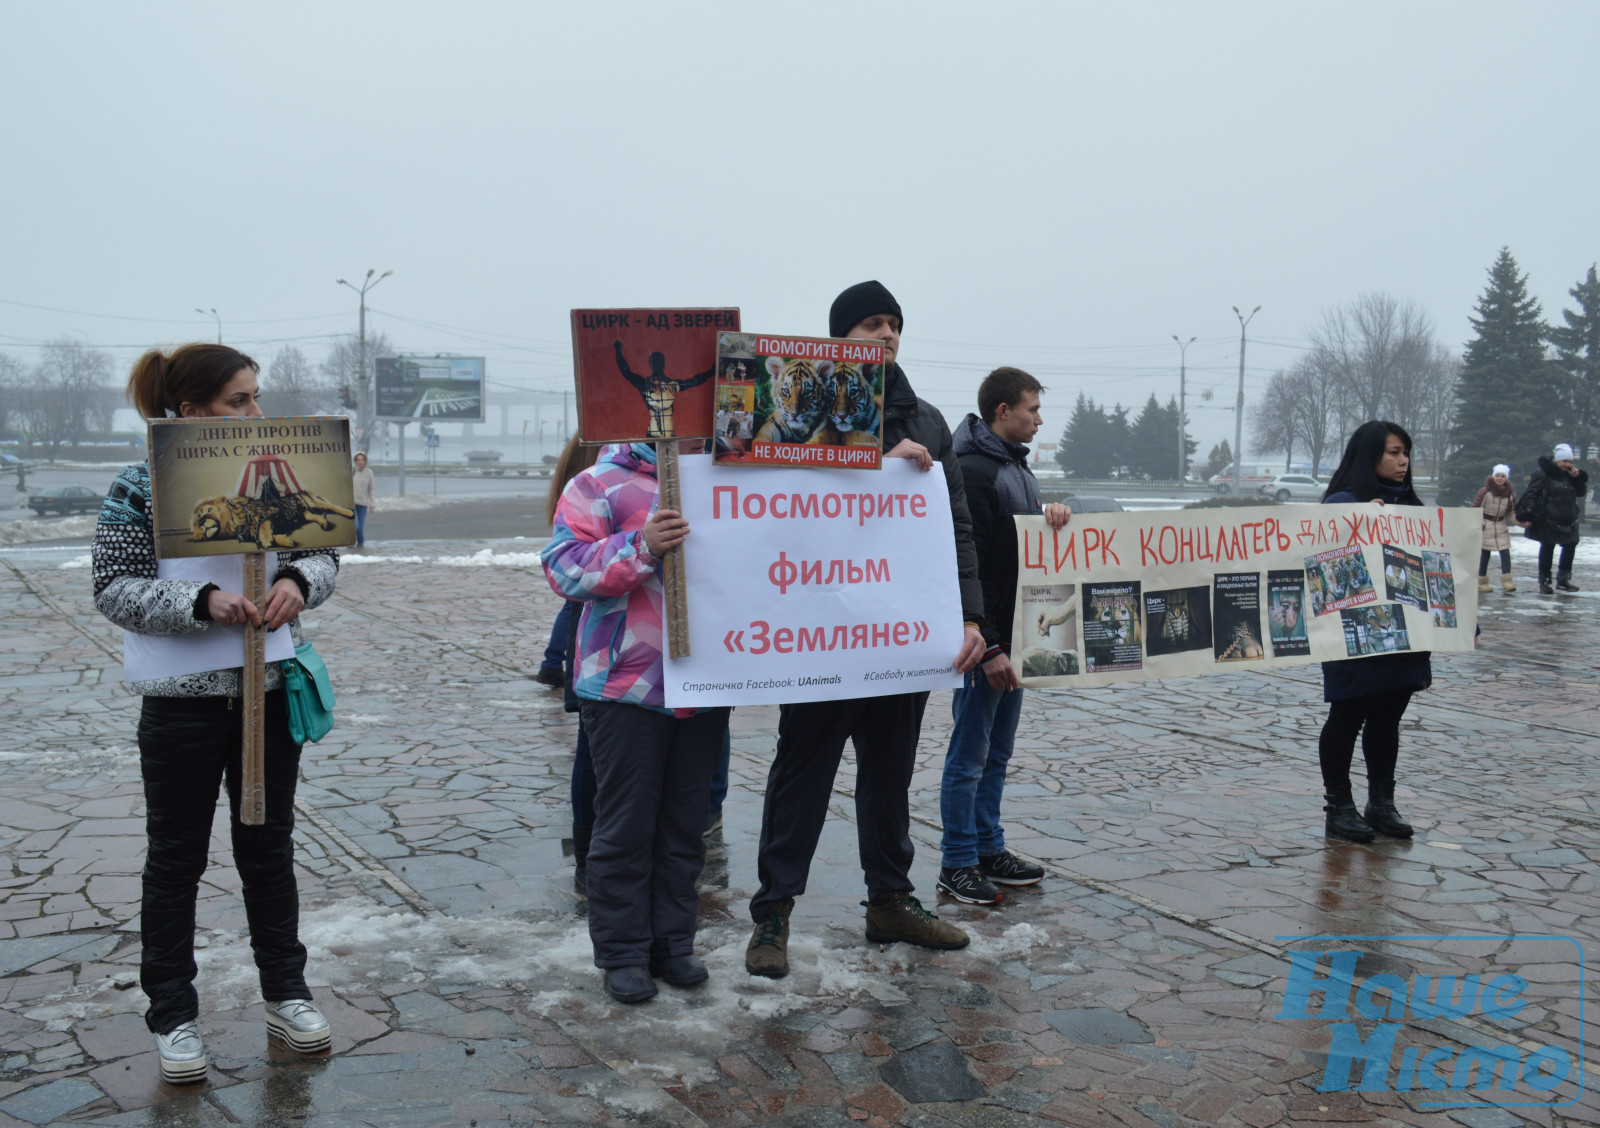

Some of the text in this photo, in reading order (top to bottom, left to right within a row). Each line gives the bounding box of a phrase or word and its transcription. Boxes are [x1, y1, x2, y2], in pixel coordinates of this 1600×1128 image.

[582, 313, 630, 330] ЦИРК
[646, 313, 671, 330] АД
[673, 310, 734, 328] ЗВЕРЕЙ
[758, 338, 882, 362] ПОМОГИТЕ НАМ!
[196, 424, 322, 443] ДНЕПР ПРОТИВ
[176, 441, 347, 460] ЦИРКА С ЖИВОТНЫМИ
[754, 445, 876, 465] НЕ ХОДИТЕ В ЦИРК!
[712, 485, 927, 527] Посмотрите
[1024, 526, 1120, 576] ЦИРК
[1140, 518, 1291, 567] КОНЦЛАГЕРЬ
[1316, 548, 1345, 561] ПОМОГИТЕ
[768, 551, 891, 595] фильм
[1030, 588, 1052, 596] ЦИРК
[1146, 597, 1162, 605] Цирк
[1334, 599, 1353, 610] ХОДИТЕ
[1358, 592, 1376, 604] ЦИРК!
[723, 618, 930, 656] «Земляне»
[682, 674, 842, 693] Страничка Facebook: UAnimals
[863, 665, 953, 683] #Свободу животным
